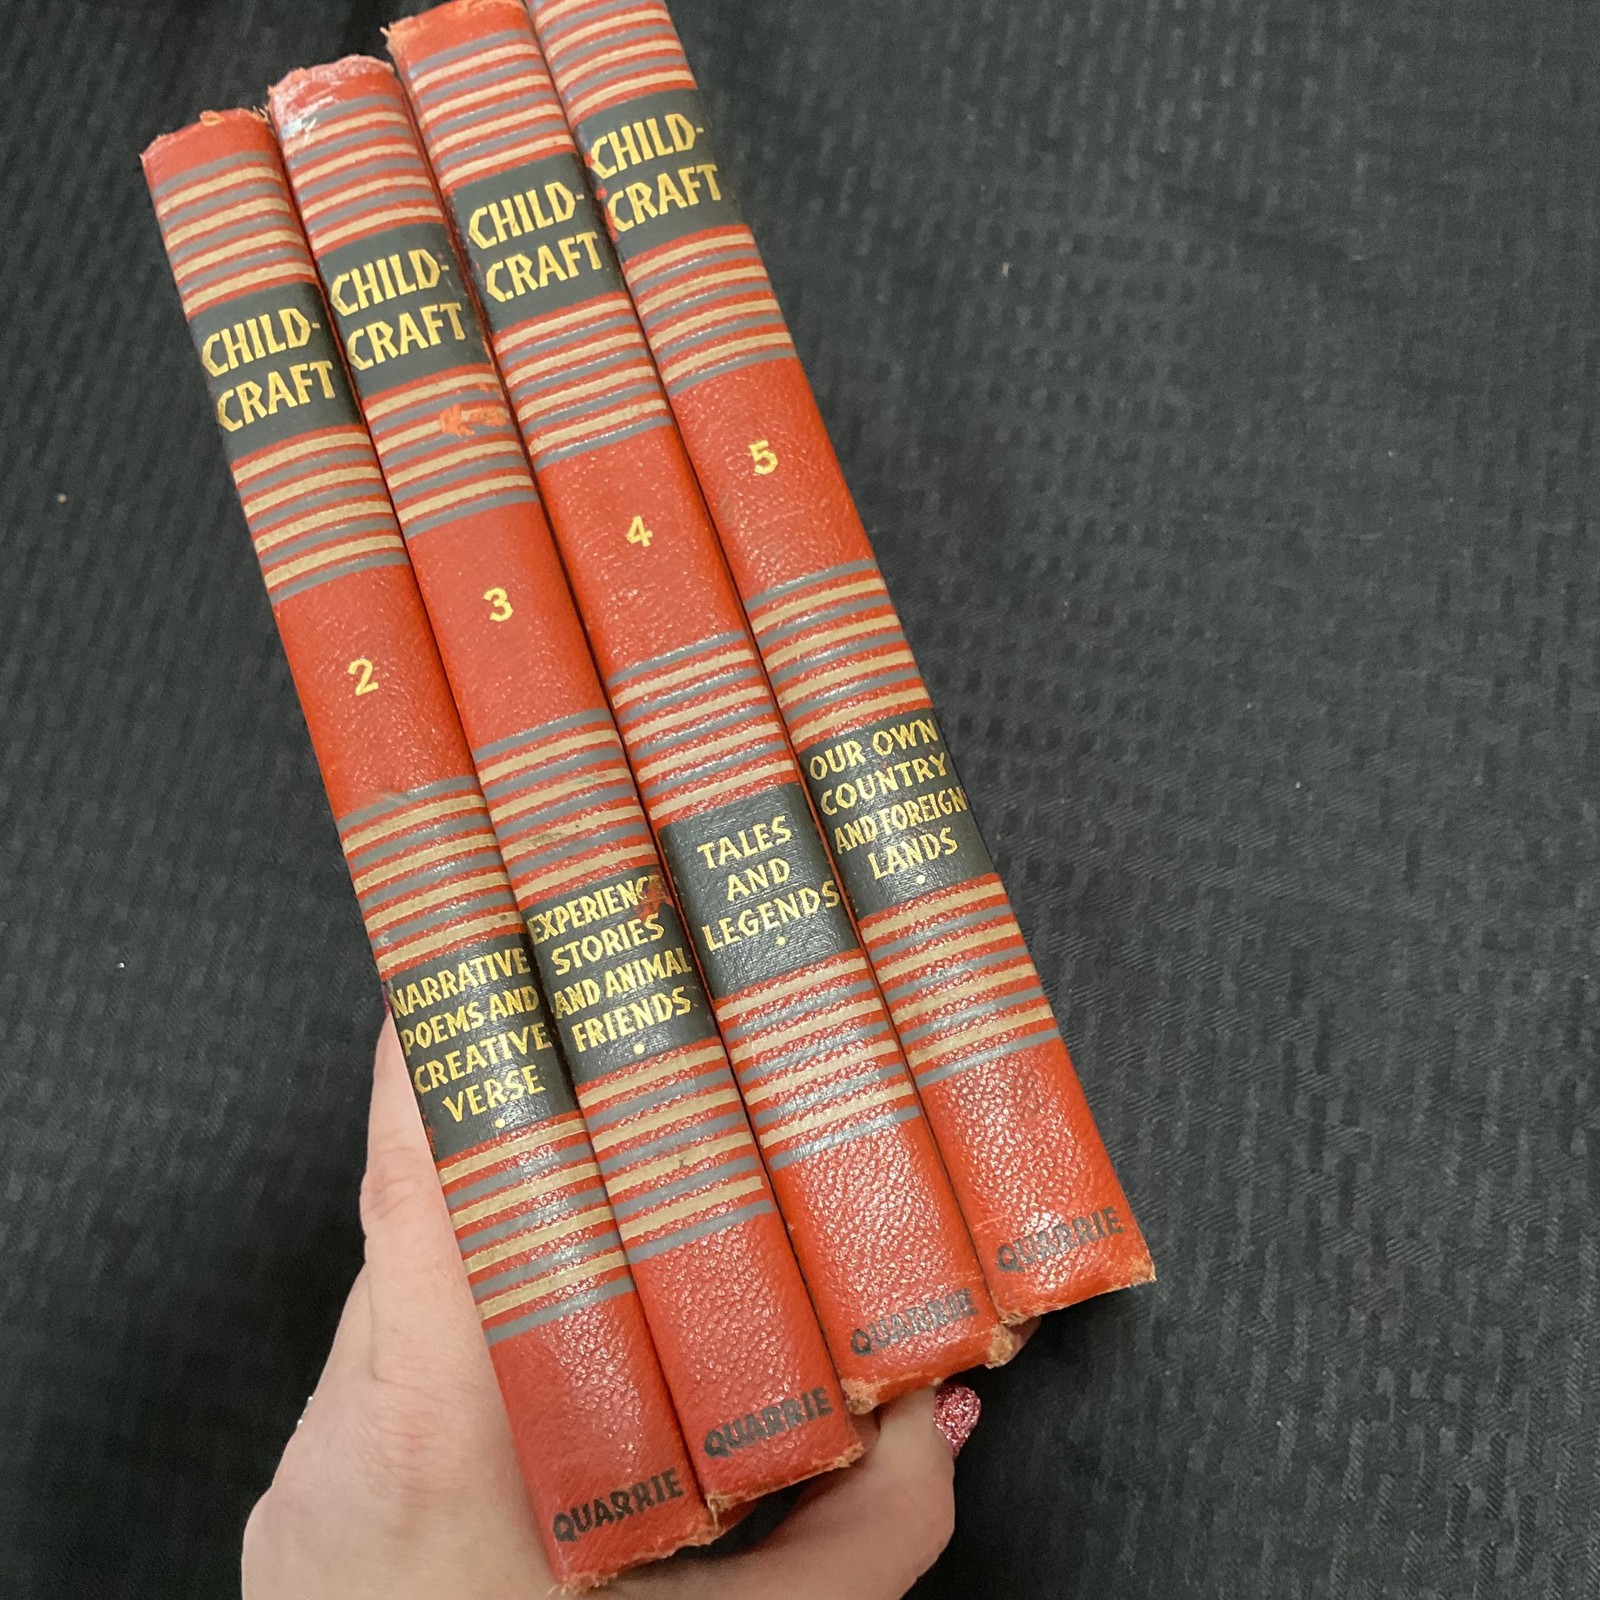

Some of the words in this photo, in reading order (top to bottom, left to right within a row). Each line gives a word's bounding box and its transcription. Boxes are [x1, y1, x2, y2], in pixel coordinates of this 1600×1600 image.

[589, 113, 705, 181] CHILD-
[468, 181, 585, 250] CHILD-
[606, 163, 723, 233] CRAFT
[330, 248, 450, 317] CHILD-
[485, 231, 604, 302] CRAFT
[202, 307, 320, 378] CHILD-
[346, 302, 467, 371] CRAFT
[217, 360, 336, 432] CRAFT
[747, 439, 779, 476] 5
[625, 514, 654, 548] 4
[483, 587, 514, 622] 3
[347, 658, 380, 697] 2
[809, 739, 867, 781] OUR
[872, 718, 940, 757] OWN
[820, 752, 949, 816] COUNTRY
[696, 815, 793, 870] TALES
[834, 814, 878, 855] AND
[877, 786, 969, 836] FOREIGN
[867, 826, 958, 880] LANDS
[726, 857, 791, 902] AND
[551, 912, 665, 976] STORIES
[701, 879, 841, 952] LEGENDS
[388, 947, 531, 1019] NARRATIVE
[554, 978, 601, 1020] AND
[604, 947, 693, 998] ANIMAL
[400, 1000, 485, 1057] POEMS
[488, 985, 540, 1022] AND
[571, 986, 691, 1053] FRIENDS
[413, 1021, 553, 1095] CREATIVE
[442, 1064, 546, 1123] VERSE
[996, 1206, 1125, 1274] QUARRIE
[849, 1287, 979, 1359] QUARRIE
[702, 1385, 834, 1459] QUARRIE
[552, 1467, 685, 1544] QUARRIE
